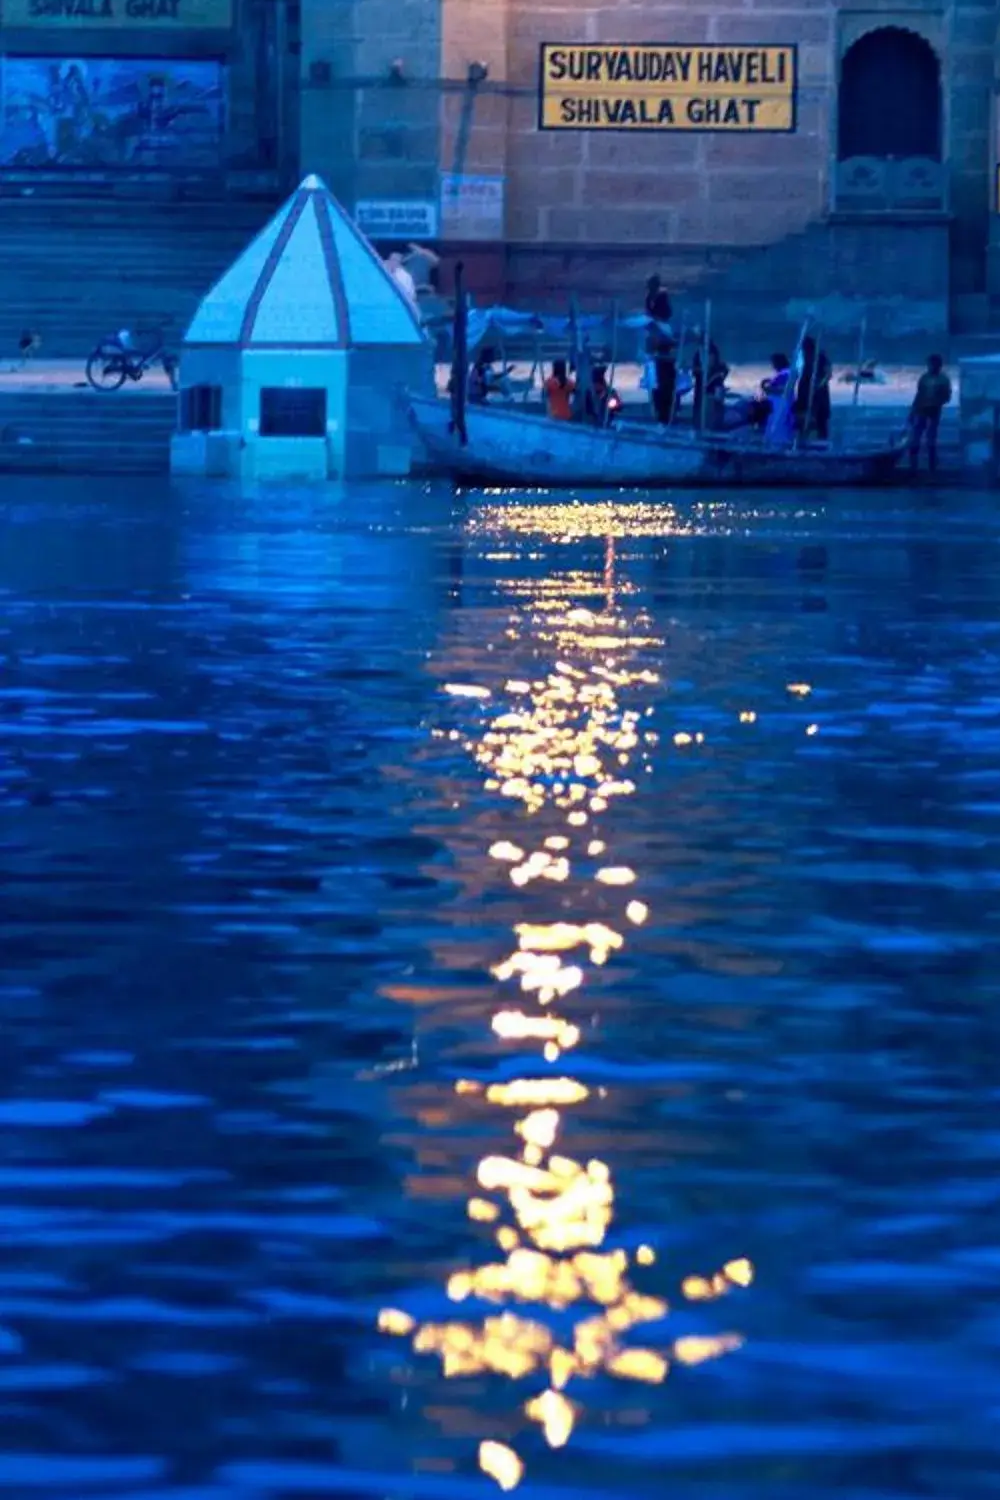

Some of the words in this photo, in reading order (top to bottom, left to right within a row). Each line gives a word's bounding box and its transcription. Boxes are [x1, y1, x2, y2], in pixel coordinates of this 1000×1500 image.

[549, 51, 692, 82] SURYAUDAY
[698, 51, 786, 84] HAVELI
[560, 98, 675, 124] SHIVALA
[686, 98, 761, 125] GHAT
